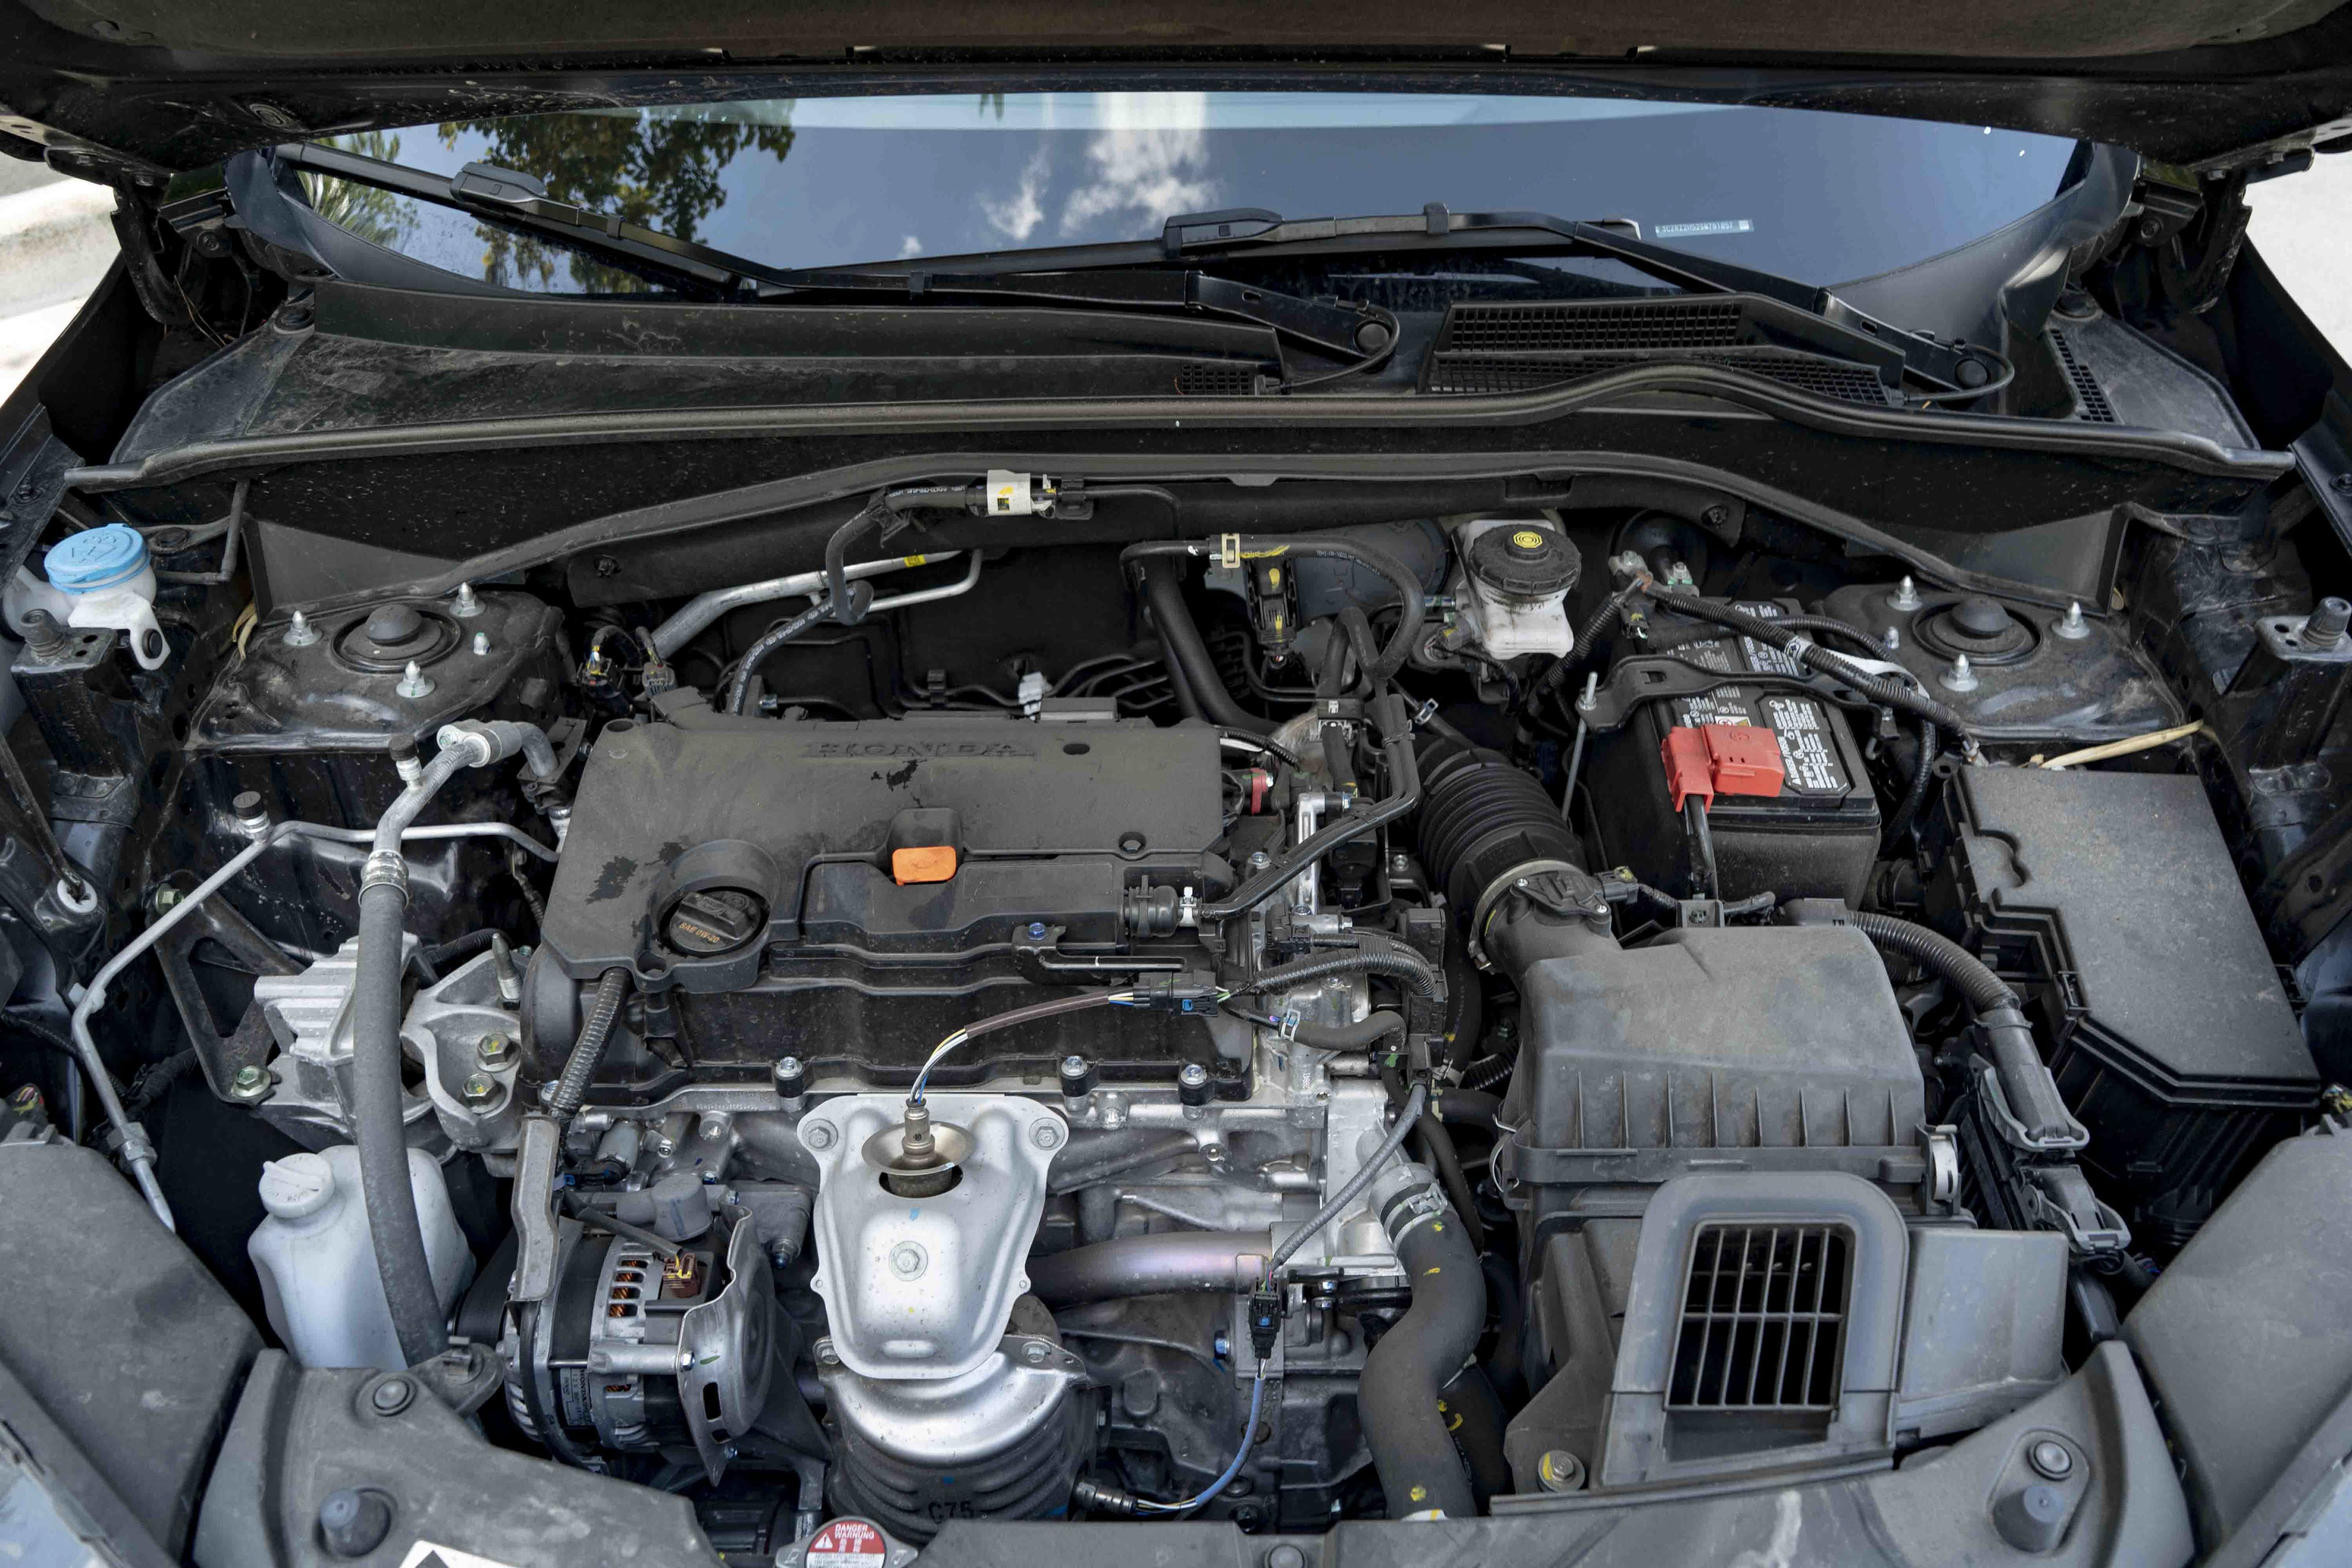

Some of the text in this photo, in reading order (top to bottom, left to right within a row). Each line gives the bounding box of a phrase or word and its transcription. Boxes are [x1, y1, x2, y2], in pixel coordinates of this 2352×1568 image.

[679, 921, 721, 943] SAE 0W-20
[835, 1523, 868, 1532] DANGER
